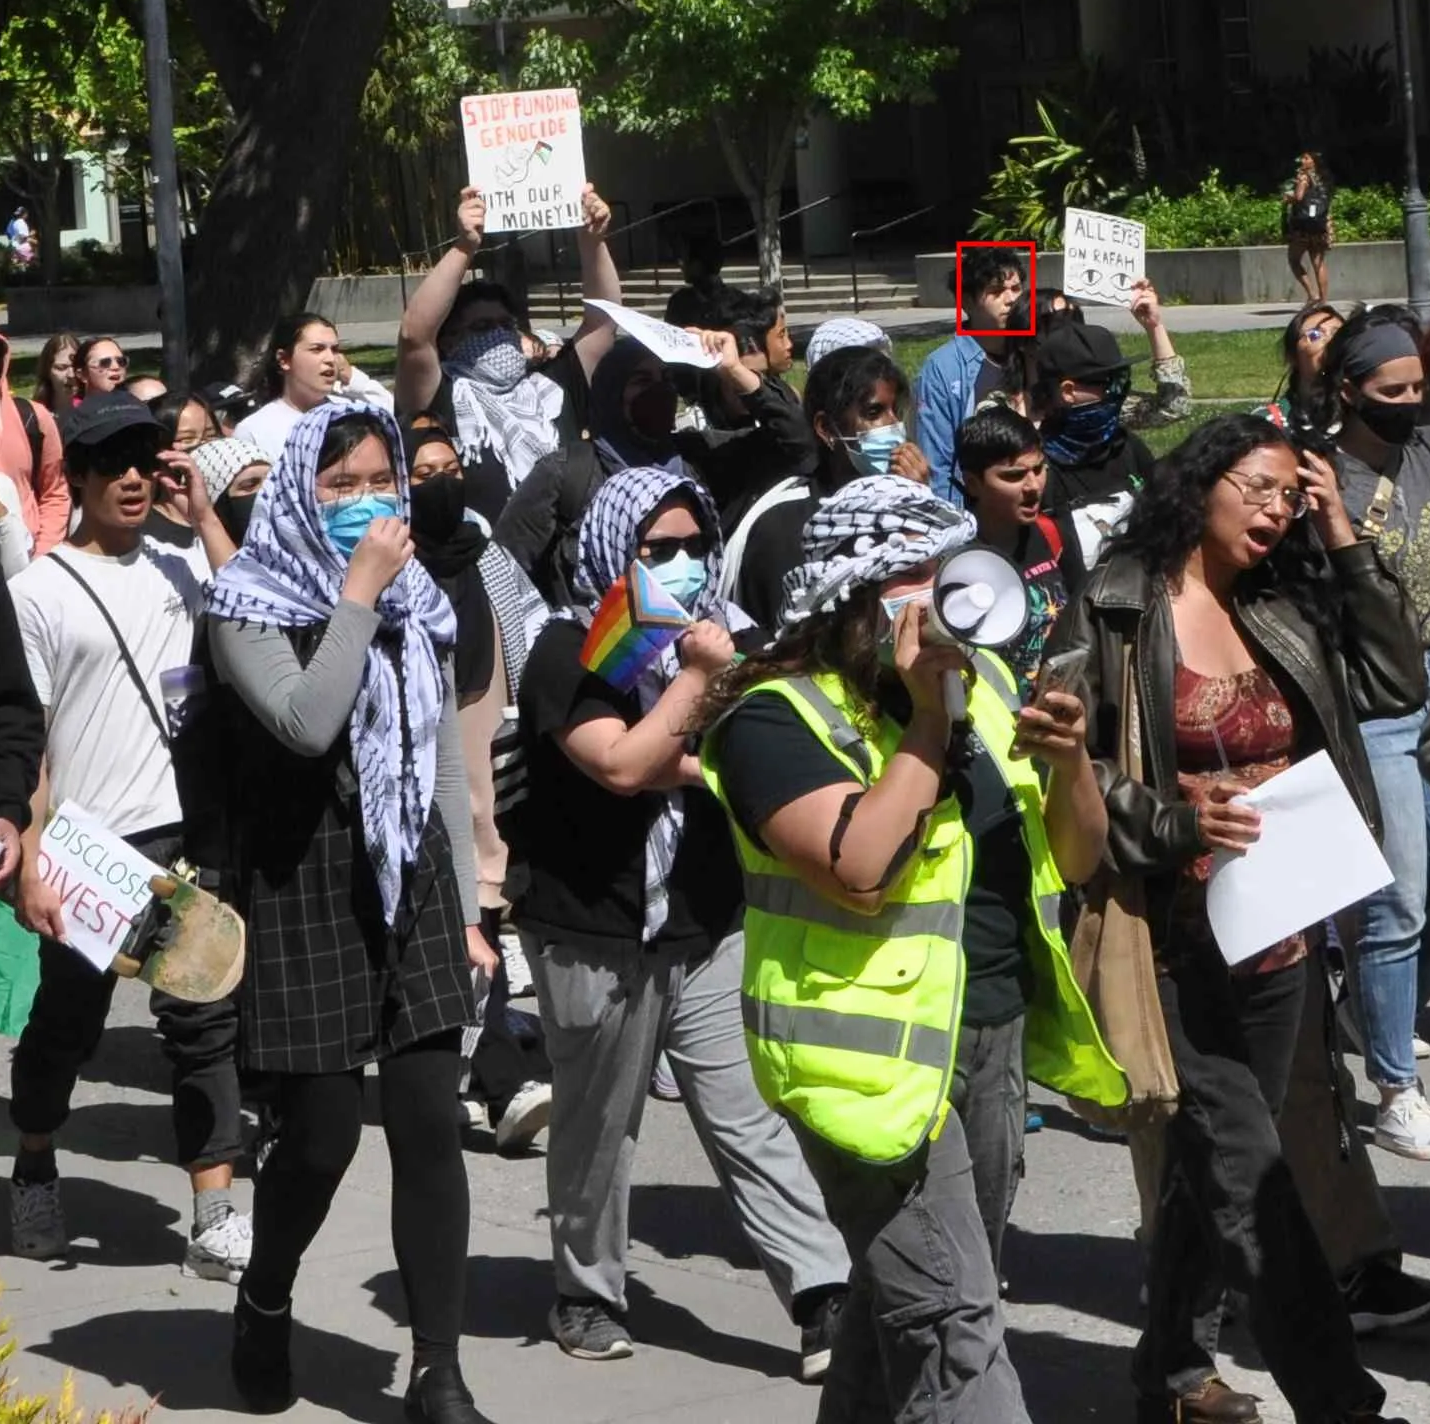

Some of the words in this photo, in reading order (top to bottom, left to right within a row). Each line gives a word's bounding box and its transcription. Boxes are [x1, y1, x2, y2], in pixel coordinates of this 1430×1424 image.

[464, 97, 509, 126] STOP
[513, 94, 577, 118] FUNDING
[480, 118, 567, 148] GENOCIDE
[528, 184, 563, 203] OUR
[502, 202, 579, 229] MONEY!!
[1075, 217, 1105, 241] ALL
[1112, 224, 1140, 248] EYES
[1068, 248, 1086, 259] ON
[1093, 249, 1134, 272] RAFAH
[49, 815, 149, 906] DISCLOSE
[39, 850, 132, 946] DIVEST
